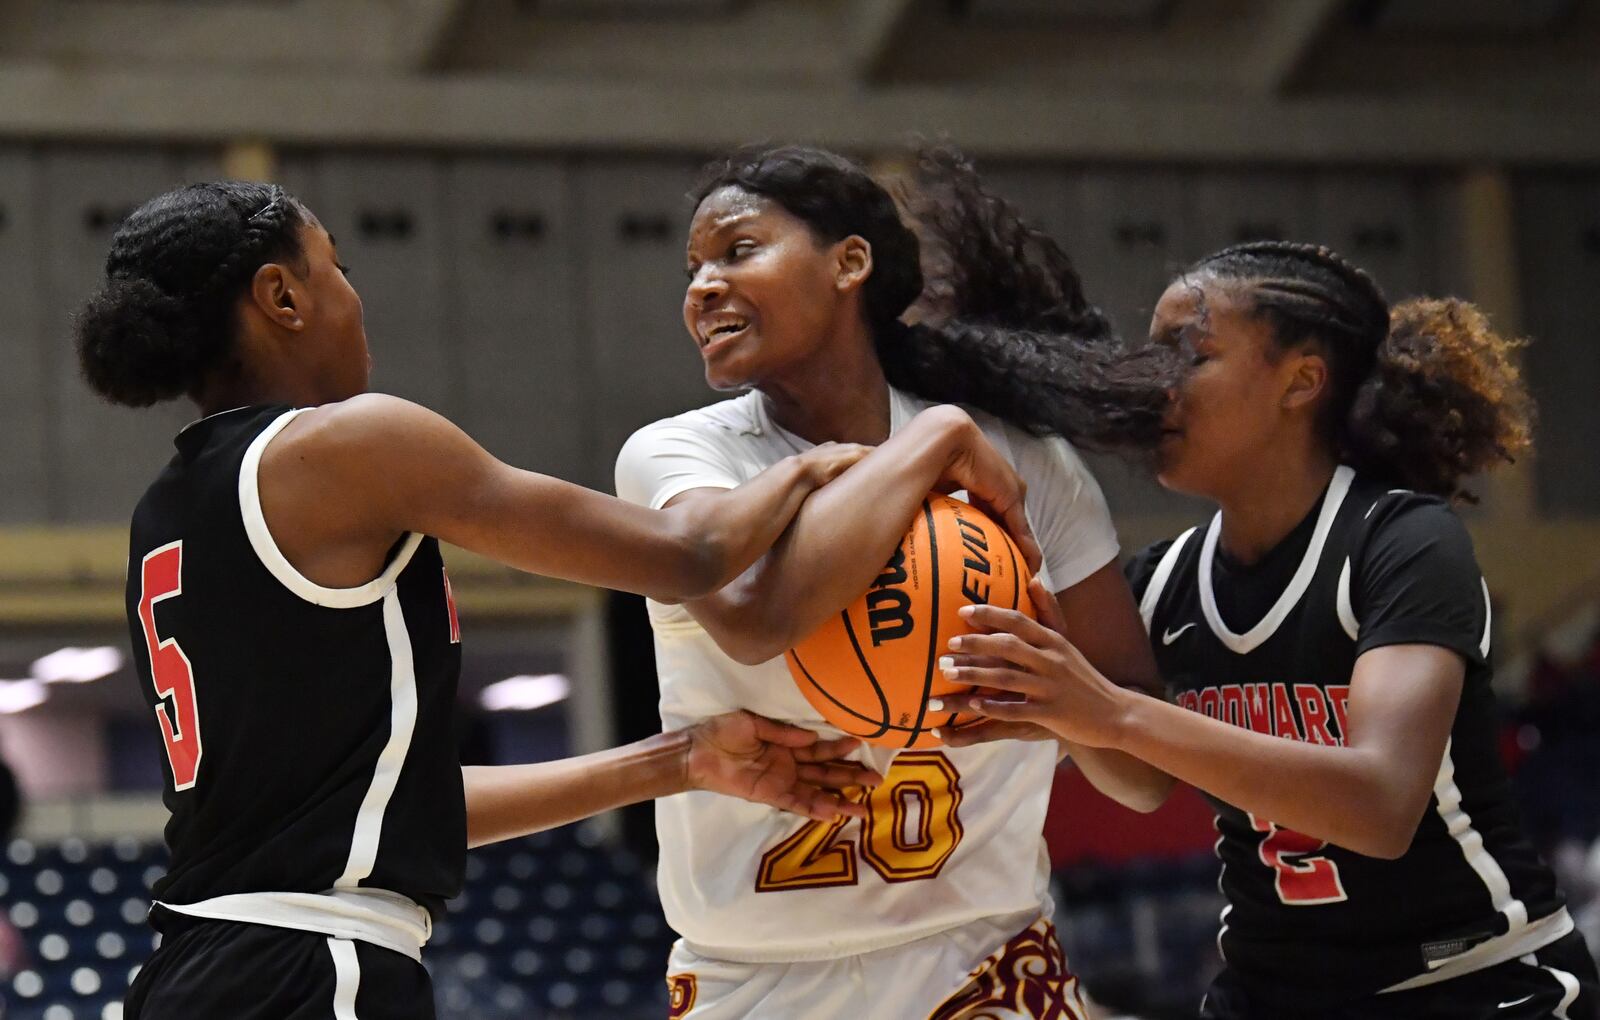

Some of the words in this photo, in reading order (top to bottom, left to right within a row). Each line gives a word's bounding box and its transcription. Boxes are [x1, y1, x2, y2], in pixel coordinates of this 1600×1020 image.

[957, 517, 990, 605] EVO
[138, 540, 202, 792] 5
[755, 751, 964, 893] 20
[1247, 811, 1348, 905] 2
